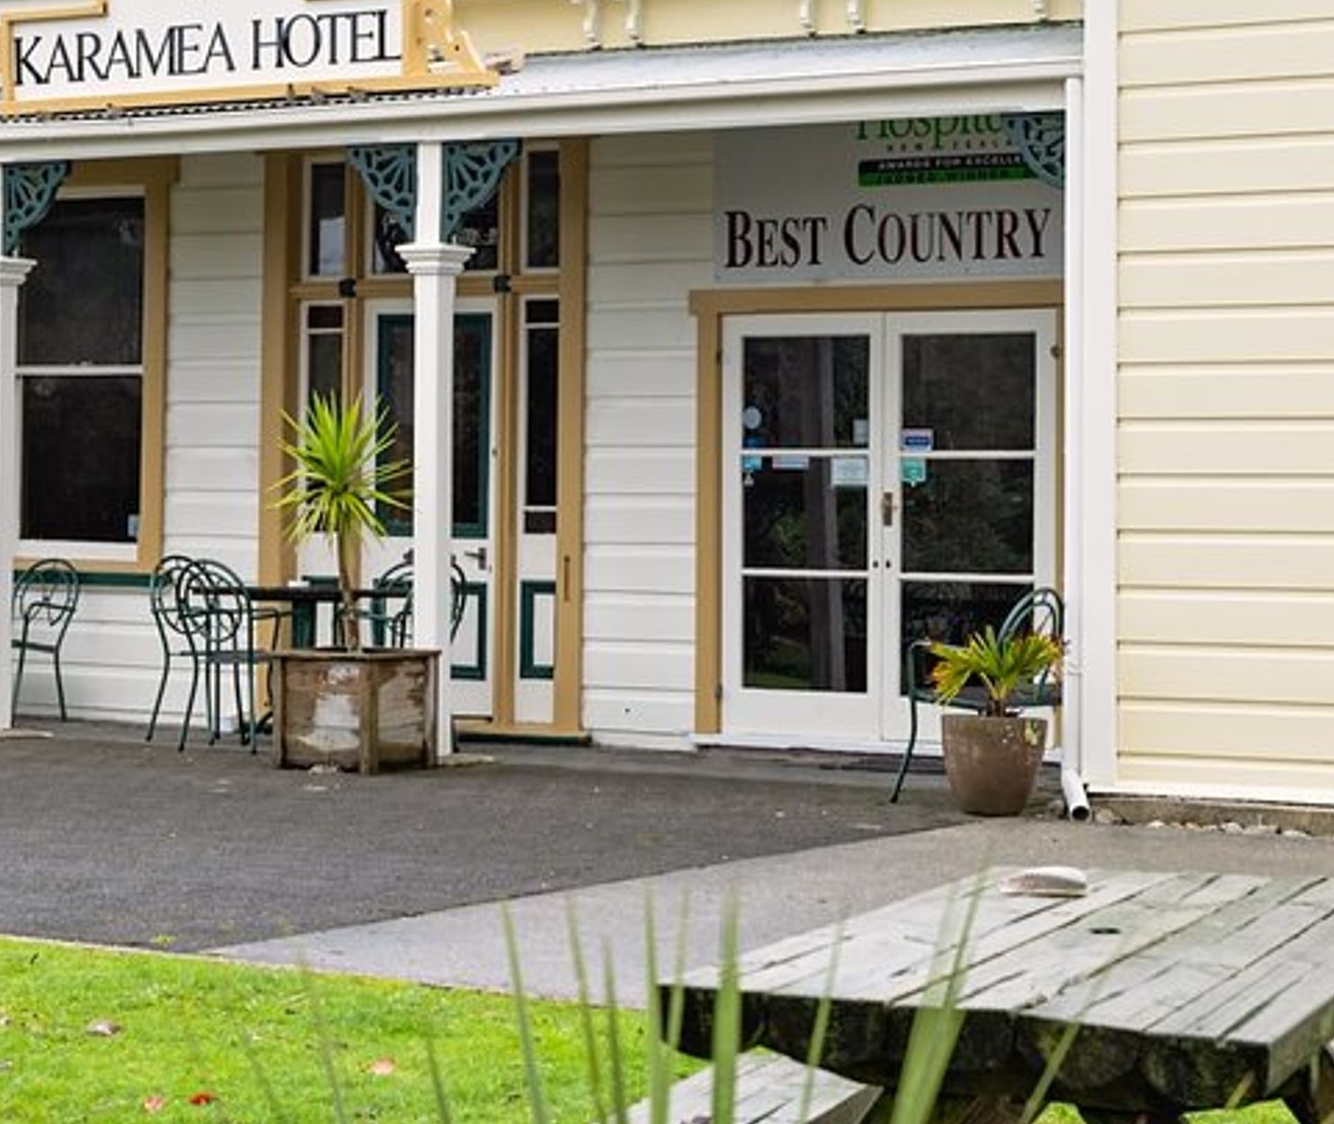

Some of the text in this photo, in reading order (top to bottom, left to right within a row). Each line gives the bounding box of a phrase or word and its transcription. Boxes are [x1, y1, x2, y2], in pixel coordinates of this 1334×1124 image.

[13, 9, 403, 85] KARAMEA HOTEL
[724, 203, 1052, 268] BEST COUNTRY
